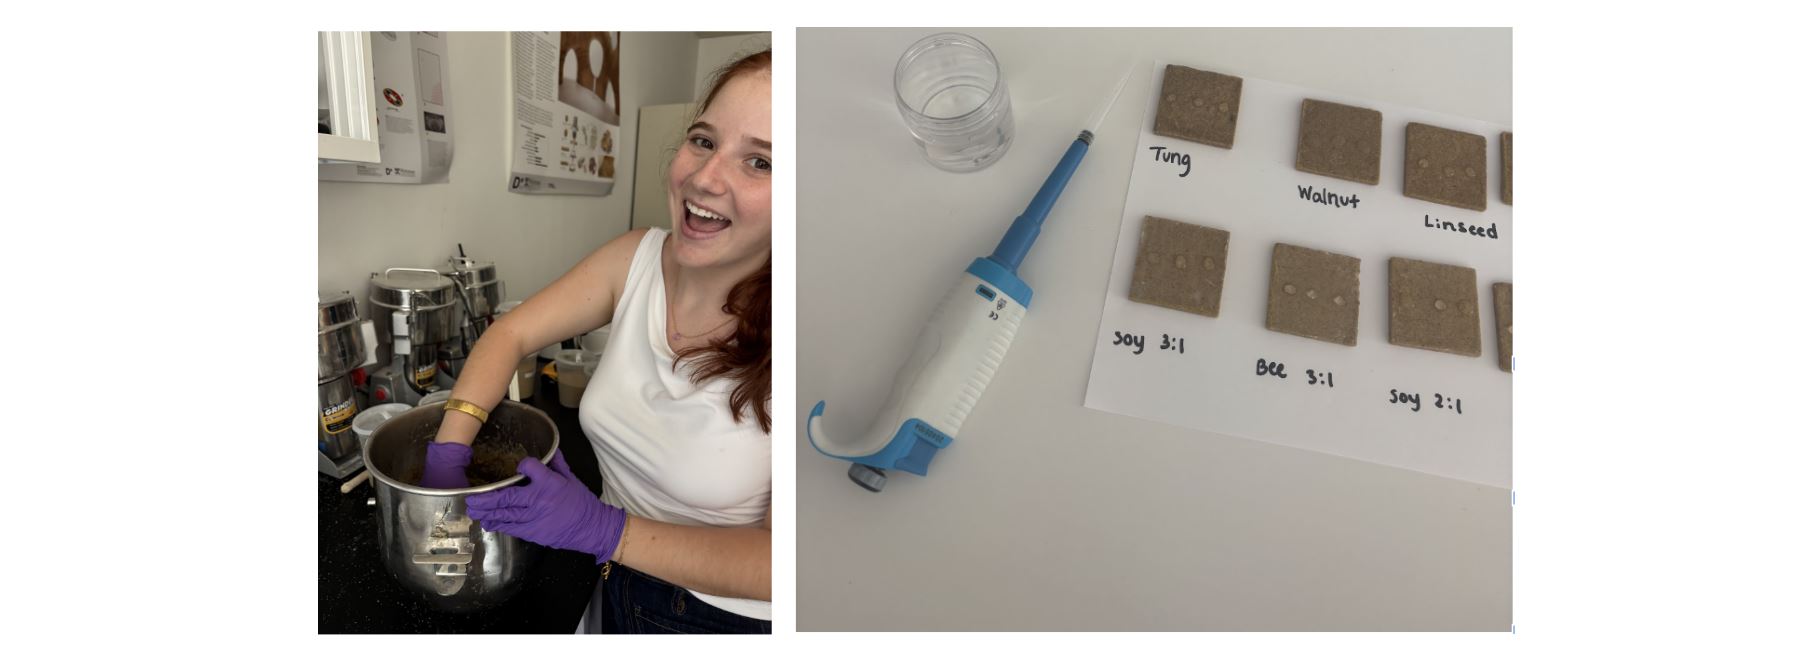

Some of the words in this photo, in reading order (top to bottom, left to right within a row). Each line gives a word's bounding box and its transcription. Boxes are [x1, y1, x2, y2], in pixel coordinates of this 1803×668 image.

[1149, 145, 1192, 178] Tung
[1297, 184, 1361, 209] Walnut
[1424, 214, 1499, 240] Linseed
[1160, 333, 1185, 355] 3:1
[1255, 358, 1288, 379] Bee
[1306, 368, 1334, 388] 3:1
[1434, 393, 1462, 415] 2:1
